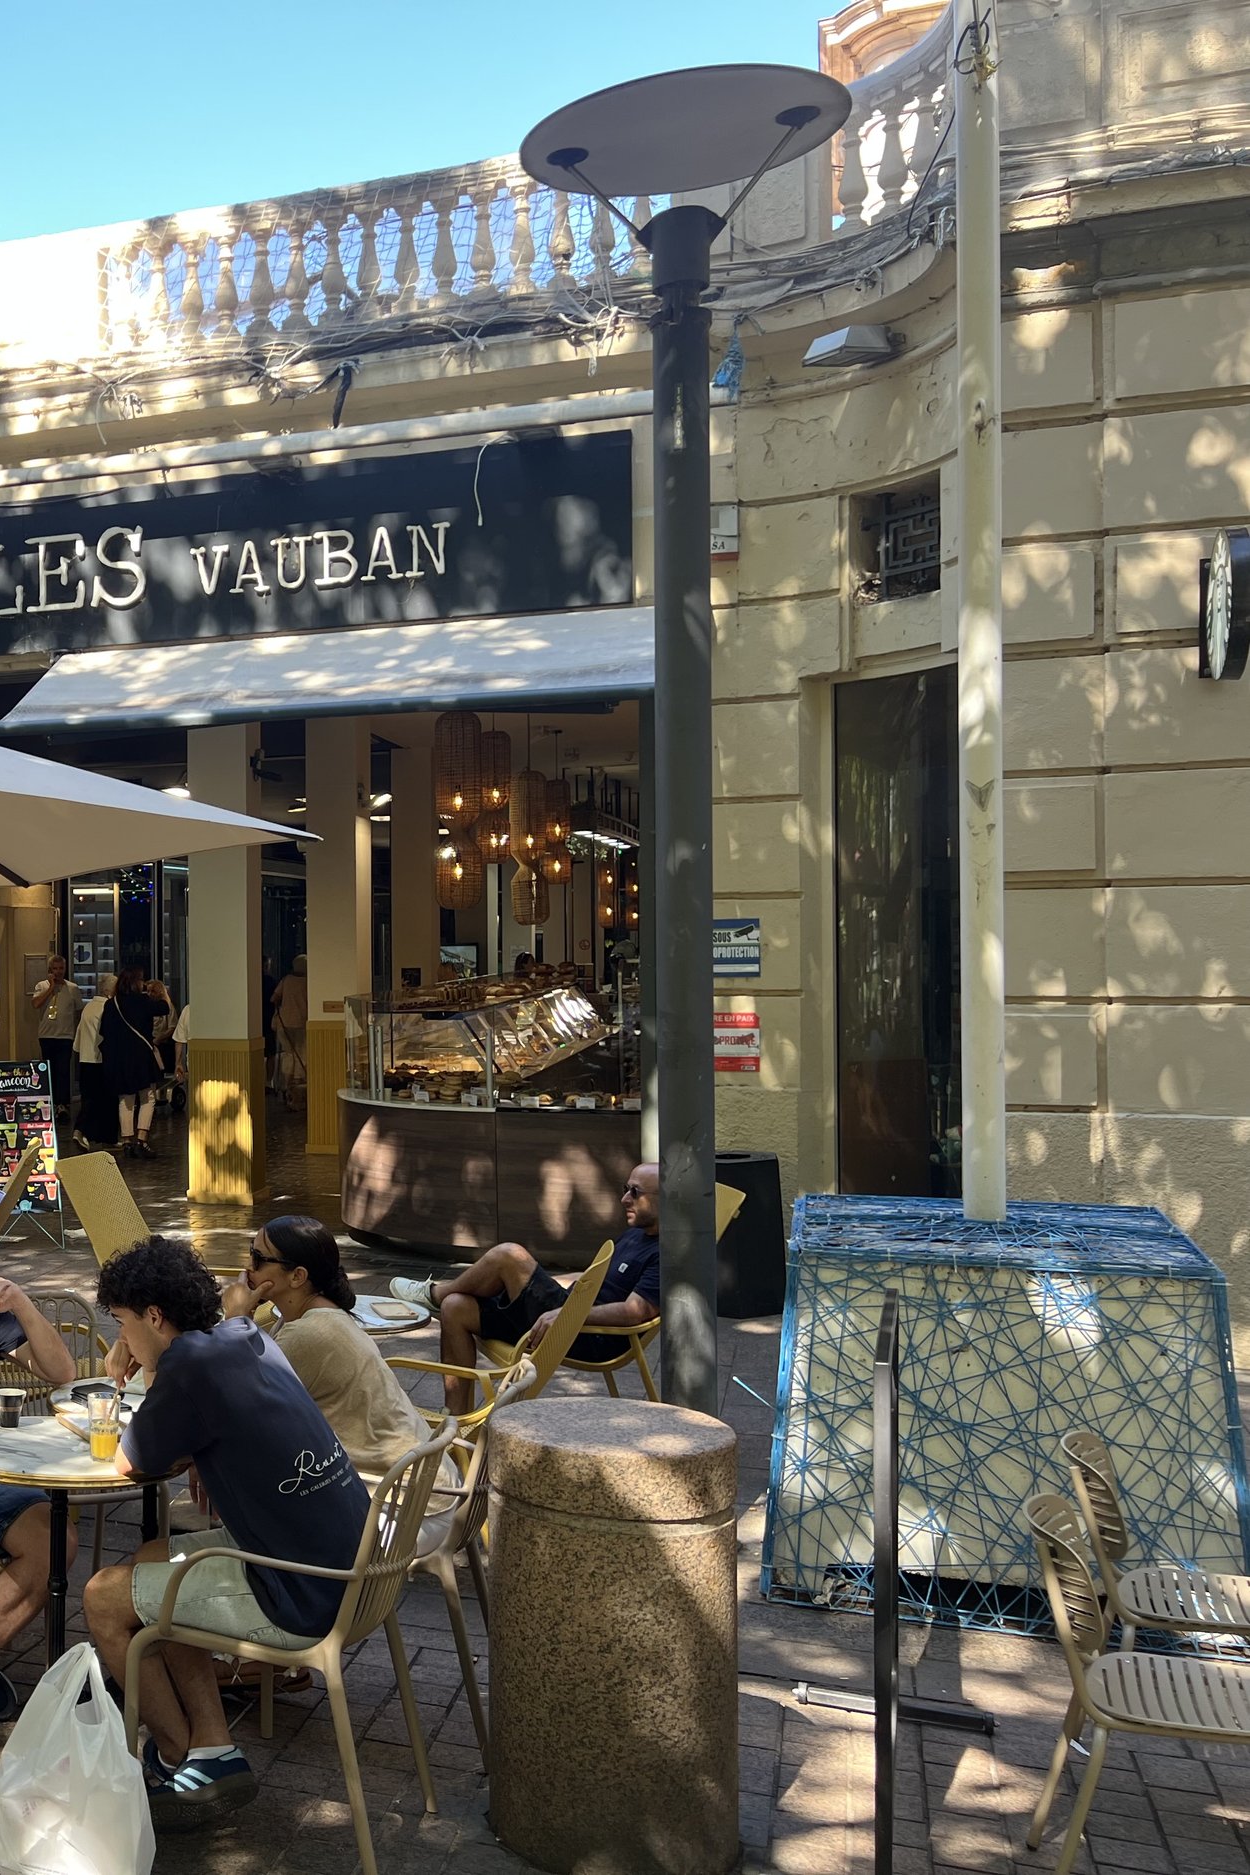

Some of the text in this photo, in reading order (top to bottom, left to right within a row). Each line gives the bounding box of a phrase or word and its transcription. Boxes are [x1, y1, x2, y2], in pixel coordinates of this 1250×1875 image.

[189, 521, 450, 596] VAUBAN
[712, 931, 732, 943] SOUS
[736, 1014, 755, 1023] PAIX
